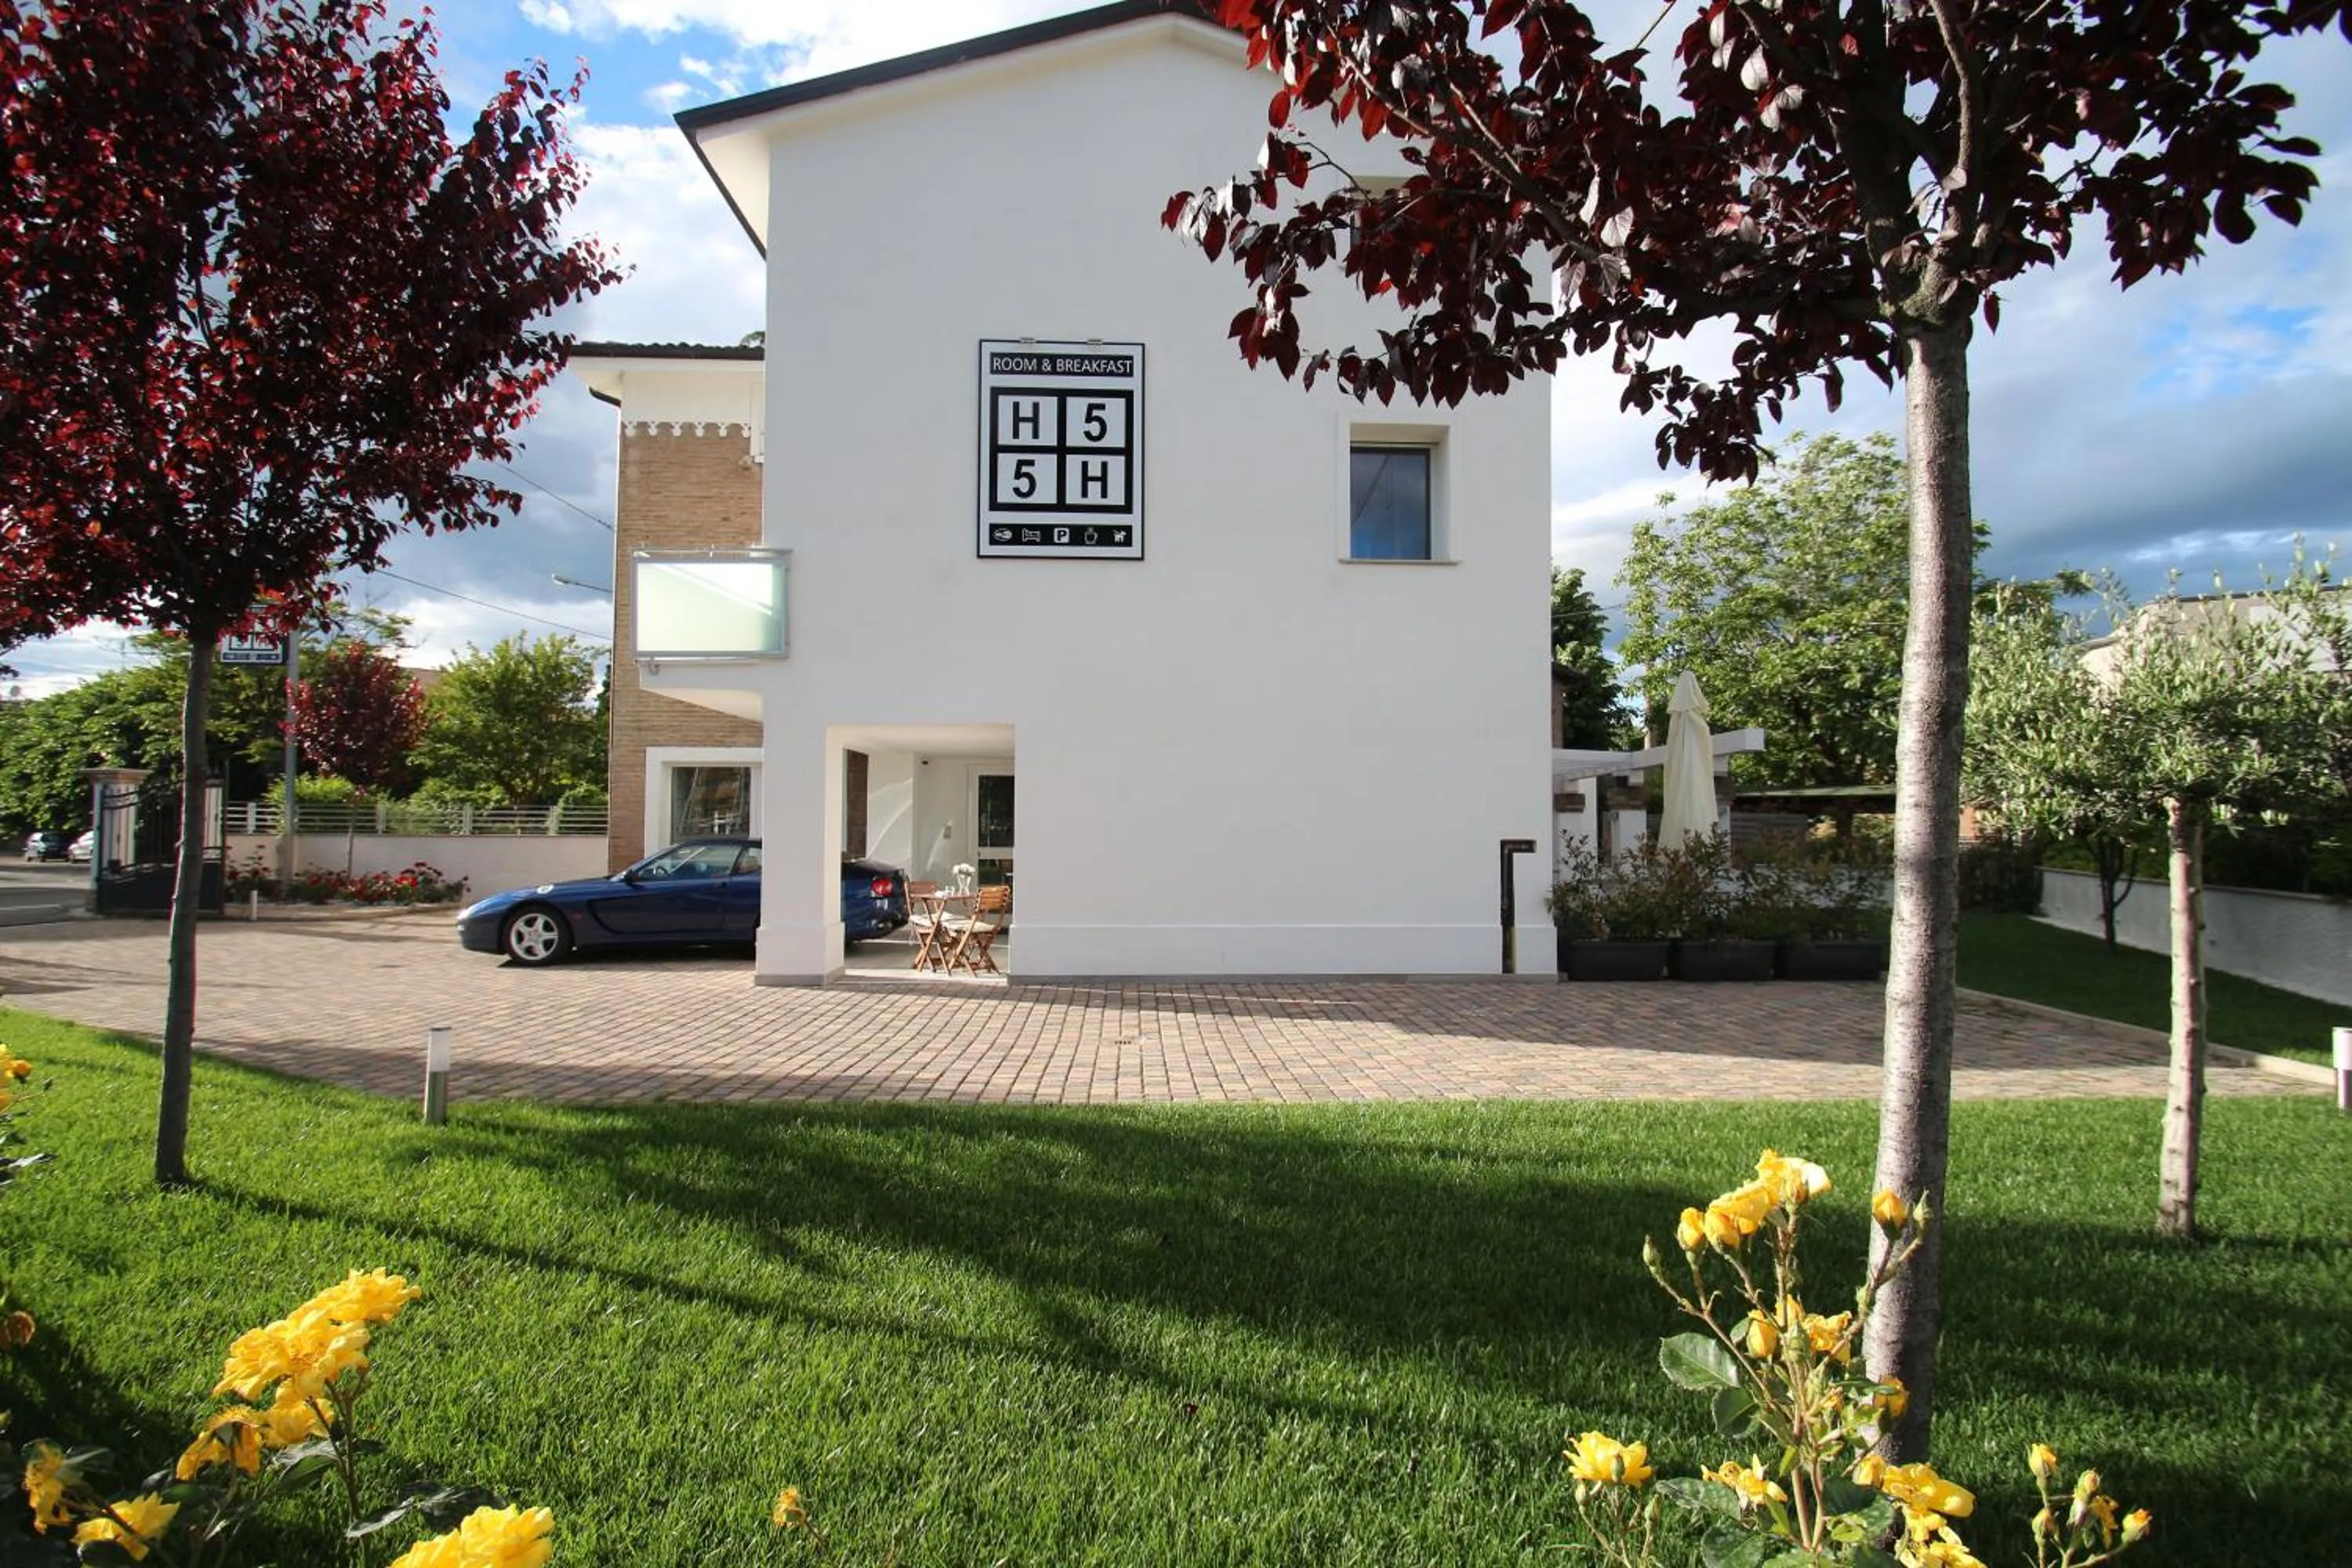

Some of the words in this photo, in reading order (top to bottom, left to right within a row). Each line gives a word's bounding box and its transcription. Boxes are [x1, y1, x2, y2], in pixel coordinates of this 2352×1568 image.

[993, 357, 1037, 372] ROOM
[1041, 358, 1051, 372] &
[1056, 358, 1132, 373] BREAKFAST
[1012, 401, 1040, 440] H
[1083, 403, 1107, 442] 5
[1012, 459, 1036, 499] 5
[1081, 461, 1108, 499] H
[1056, 528, 1067, 542] P
